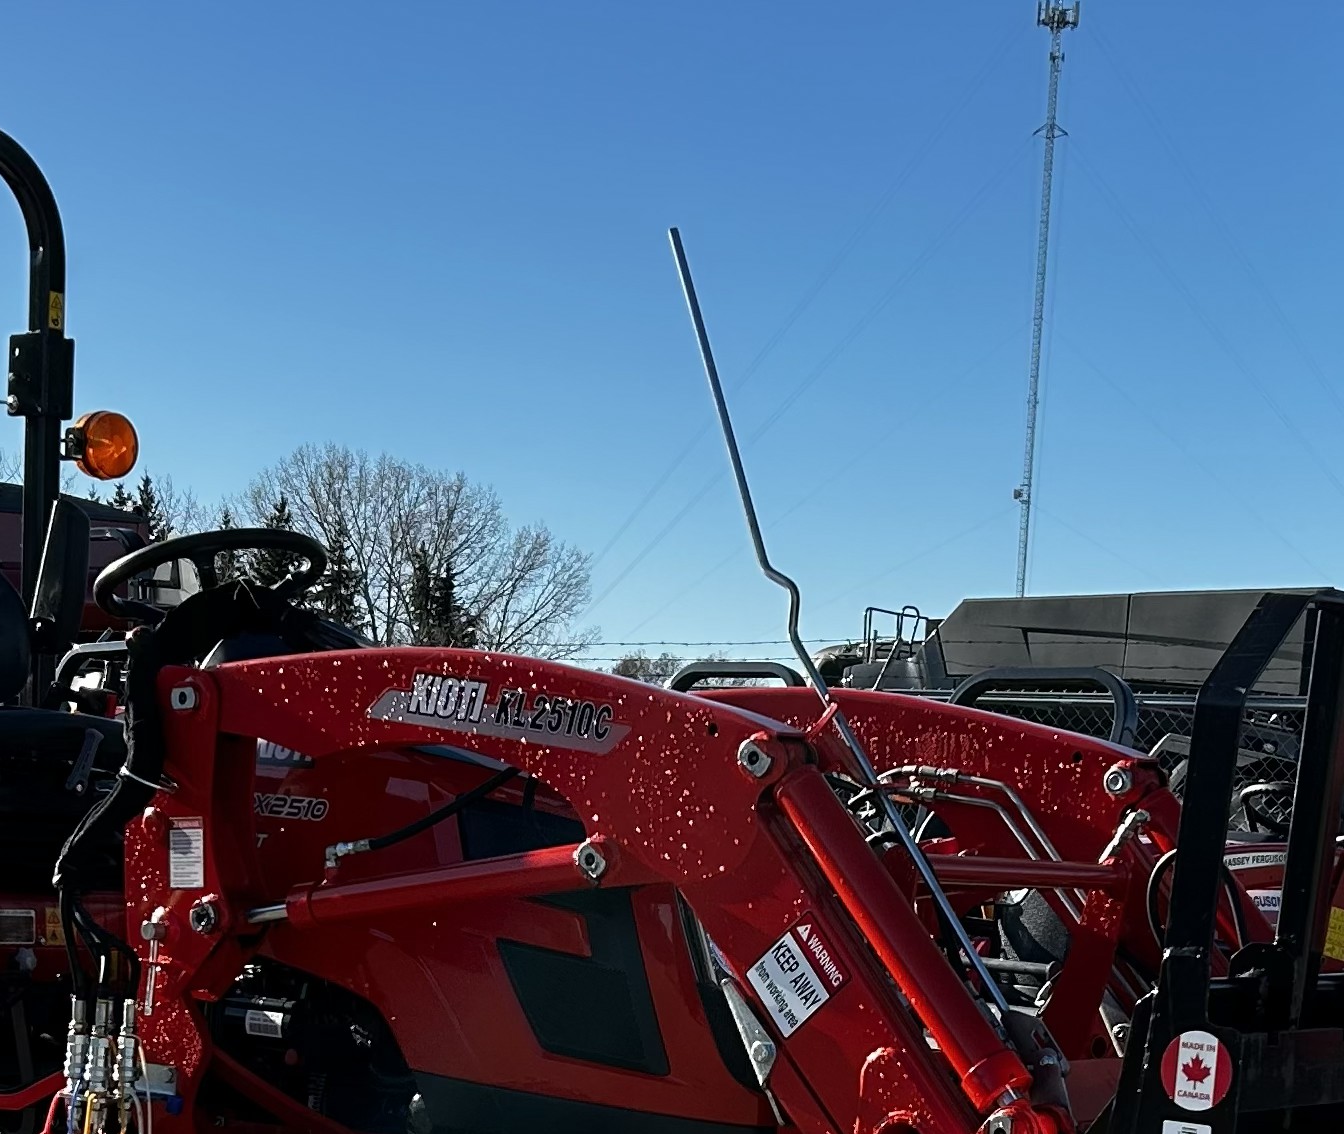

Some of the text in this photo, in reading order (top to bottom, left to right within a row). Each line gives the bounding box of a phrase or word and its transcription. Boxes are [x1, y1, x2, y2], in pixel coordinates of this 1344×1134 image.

[408, 672, 489, 724] KIOTI
[1224, 856, 1251, 867] ASSEY
[771, 940, 822, 1011] KEEP AWAY
[807, 933, 843, 988] WARNING
[1181, 1041, 1216, 1053] MADE IN
[1177, 1089, 1211, 1101] CANADA
